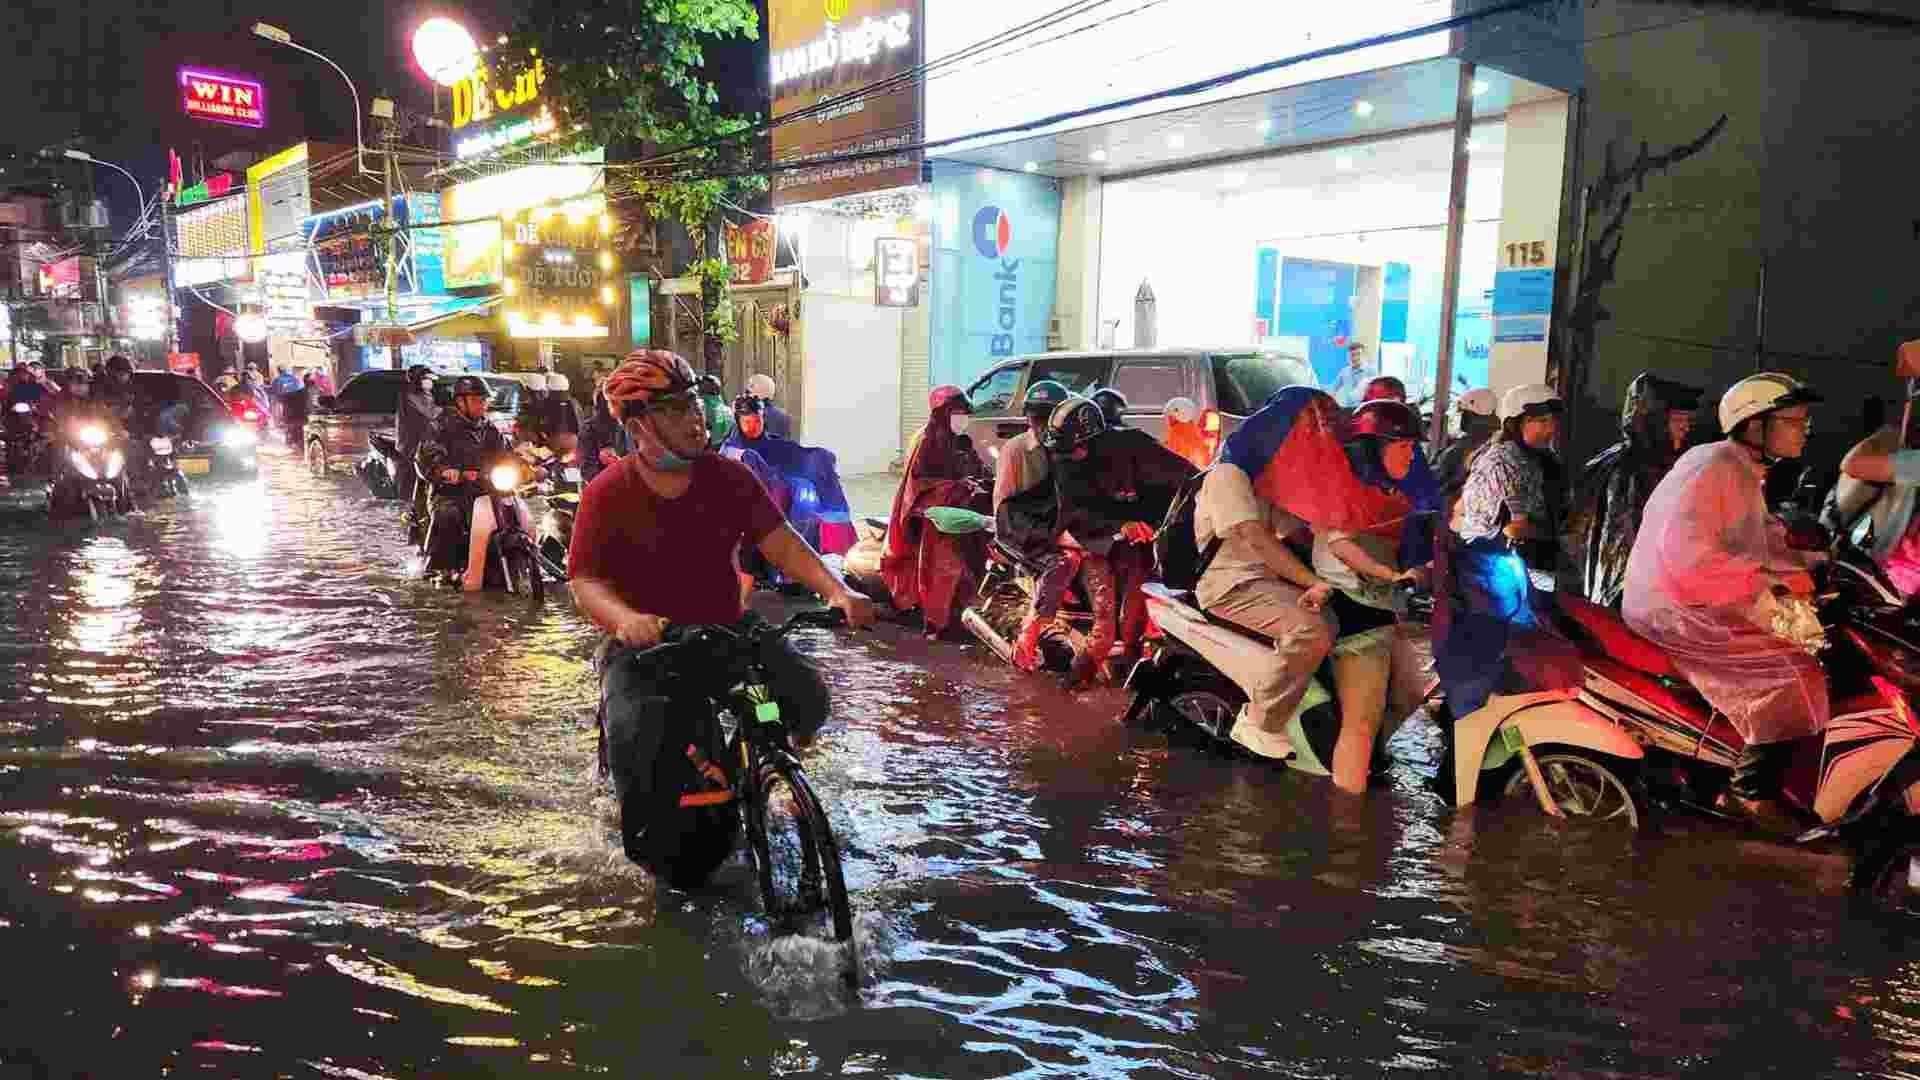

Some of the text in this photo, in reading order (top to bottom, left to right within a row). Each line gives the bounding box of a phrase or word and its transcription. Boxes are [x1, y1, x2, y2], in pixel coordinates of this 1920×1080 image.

[192, 80, 253, 106] WIN
[1504, 240, 1545, 267] 115
[991, 255, 1024, 356] Bank
